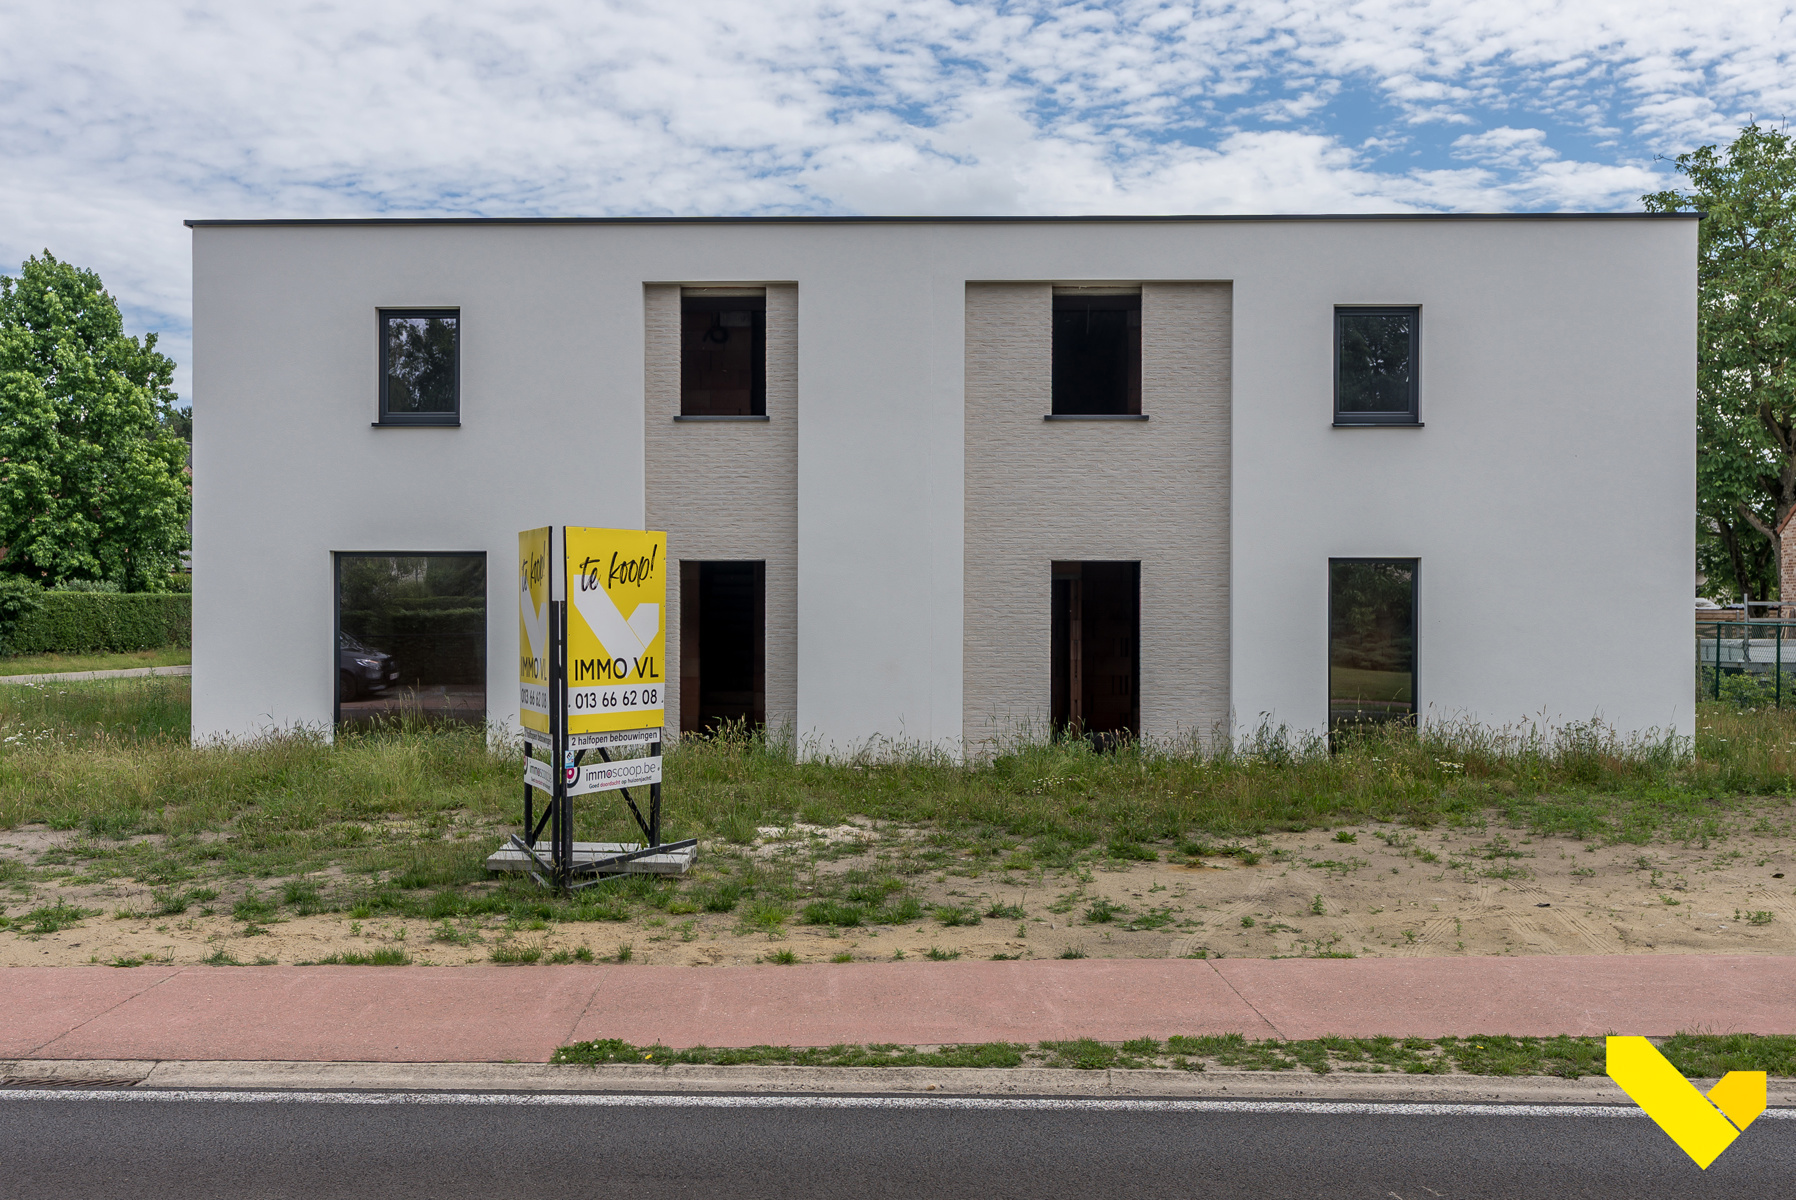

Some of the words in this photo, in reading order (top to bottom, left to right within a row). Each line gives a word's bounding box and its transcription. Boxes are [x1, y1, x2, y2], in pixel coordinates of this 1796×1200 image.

[579, 556, 601, 592] te
[608, 543, 658, 589] koop!
[520, 656, 539, 679] IMMO
[575, 657, 628, 681] IMMO
[633, 656, 659, 679] VL
[575, 692, 597, 709] 013
[602, 691, 617, 707] 66
[622, 690, 637, 706] 62
[642, 689, 658, 705] 08
[571, 737, 576, 746] 2
[578, 735, 608, 746] halfopen
[609, 732, 658, 743] bebouwingen
[585, 762, 656, 782] immoscoop.be
